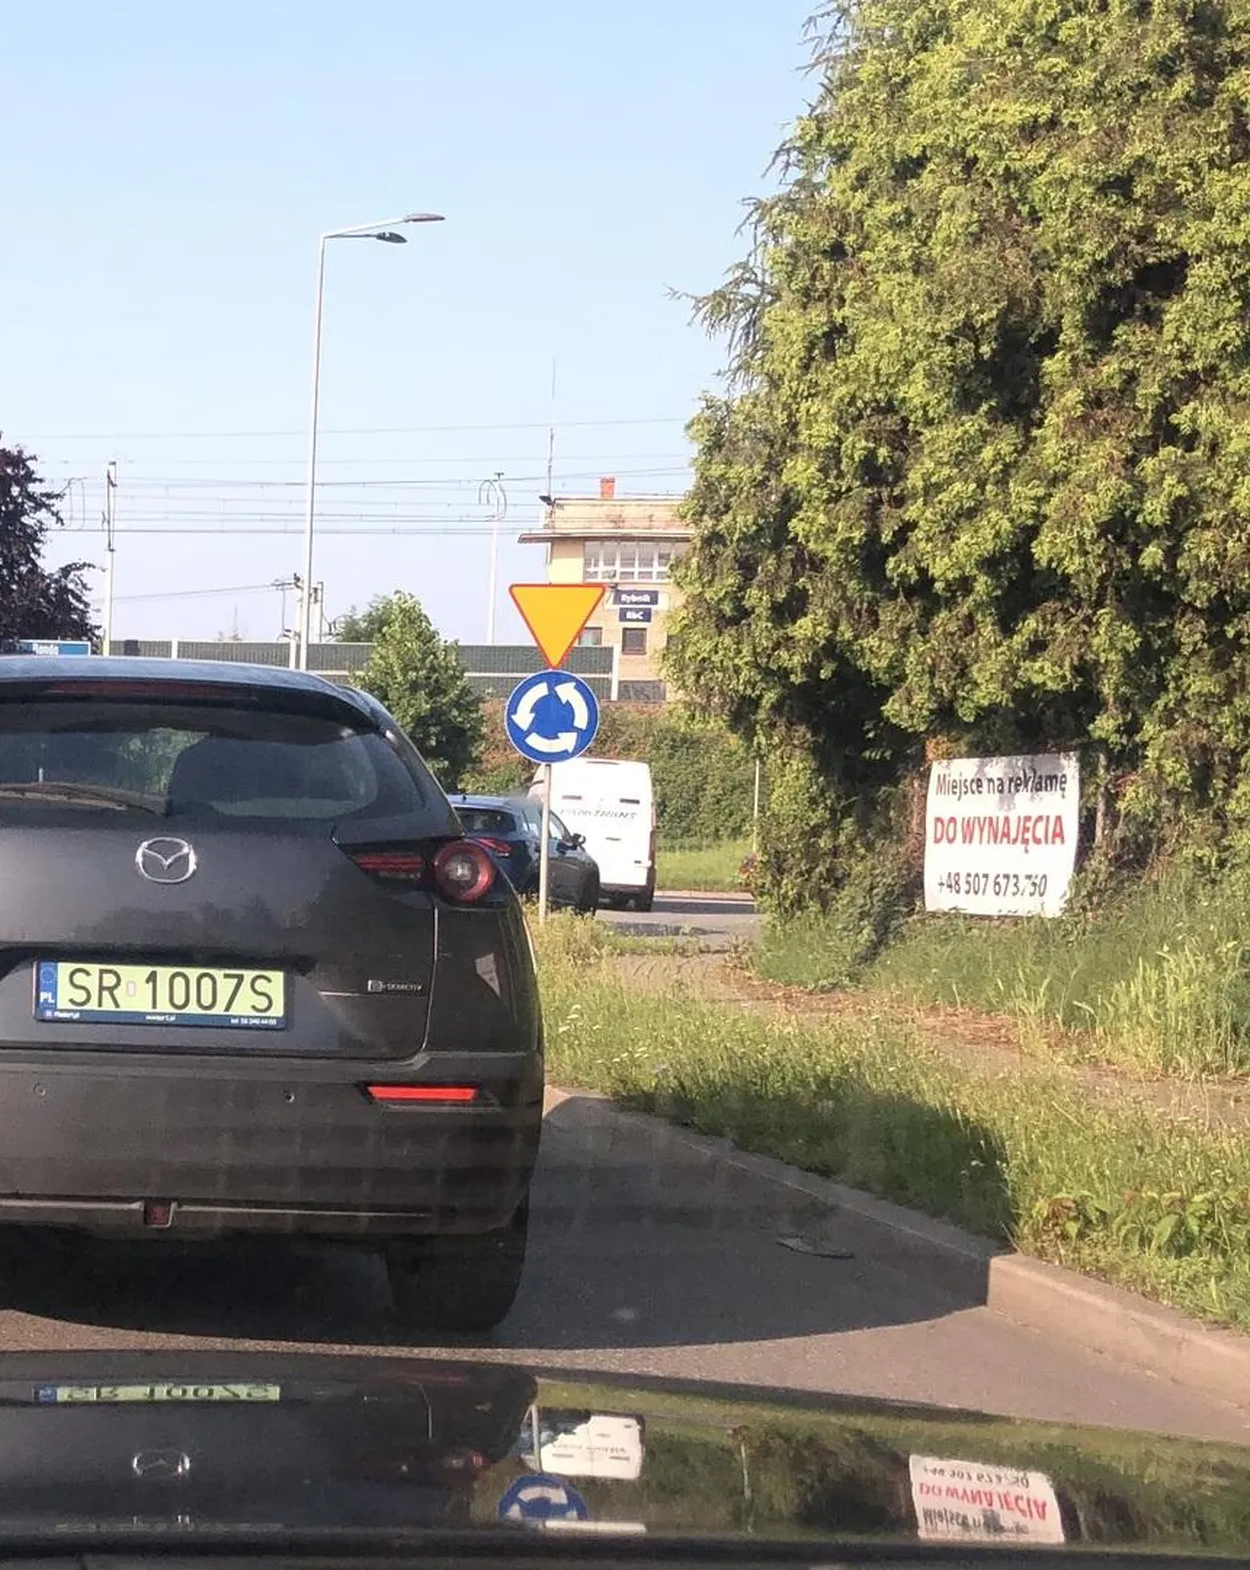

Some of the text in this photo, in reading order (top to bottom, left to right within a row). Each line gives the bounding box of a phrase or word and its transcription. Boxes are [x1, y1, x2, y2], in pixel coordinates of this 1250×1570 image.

[935, 768, 1067, 801] Miejsce na reklamę
[933, 814, 1065, 854] DO WYNAJĘCIA
[937, 871, 961, 895] +48
[964, 872, 989, 896] 507
[993, 873, 1019, 897] 673
[40, 991, 55, 1004] PL
[68, 967, 274, 1013] SR 1007S
